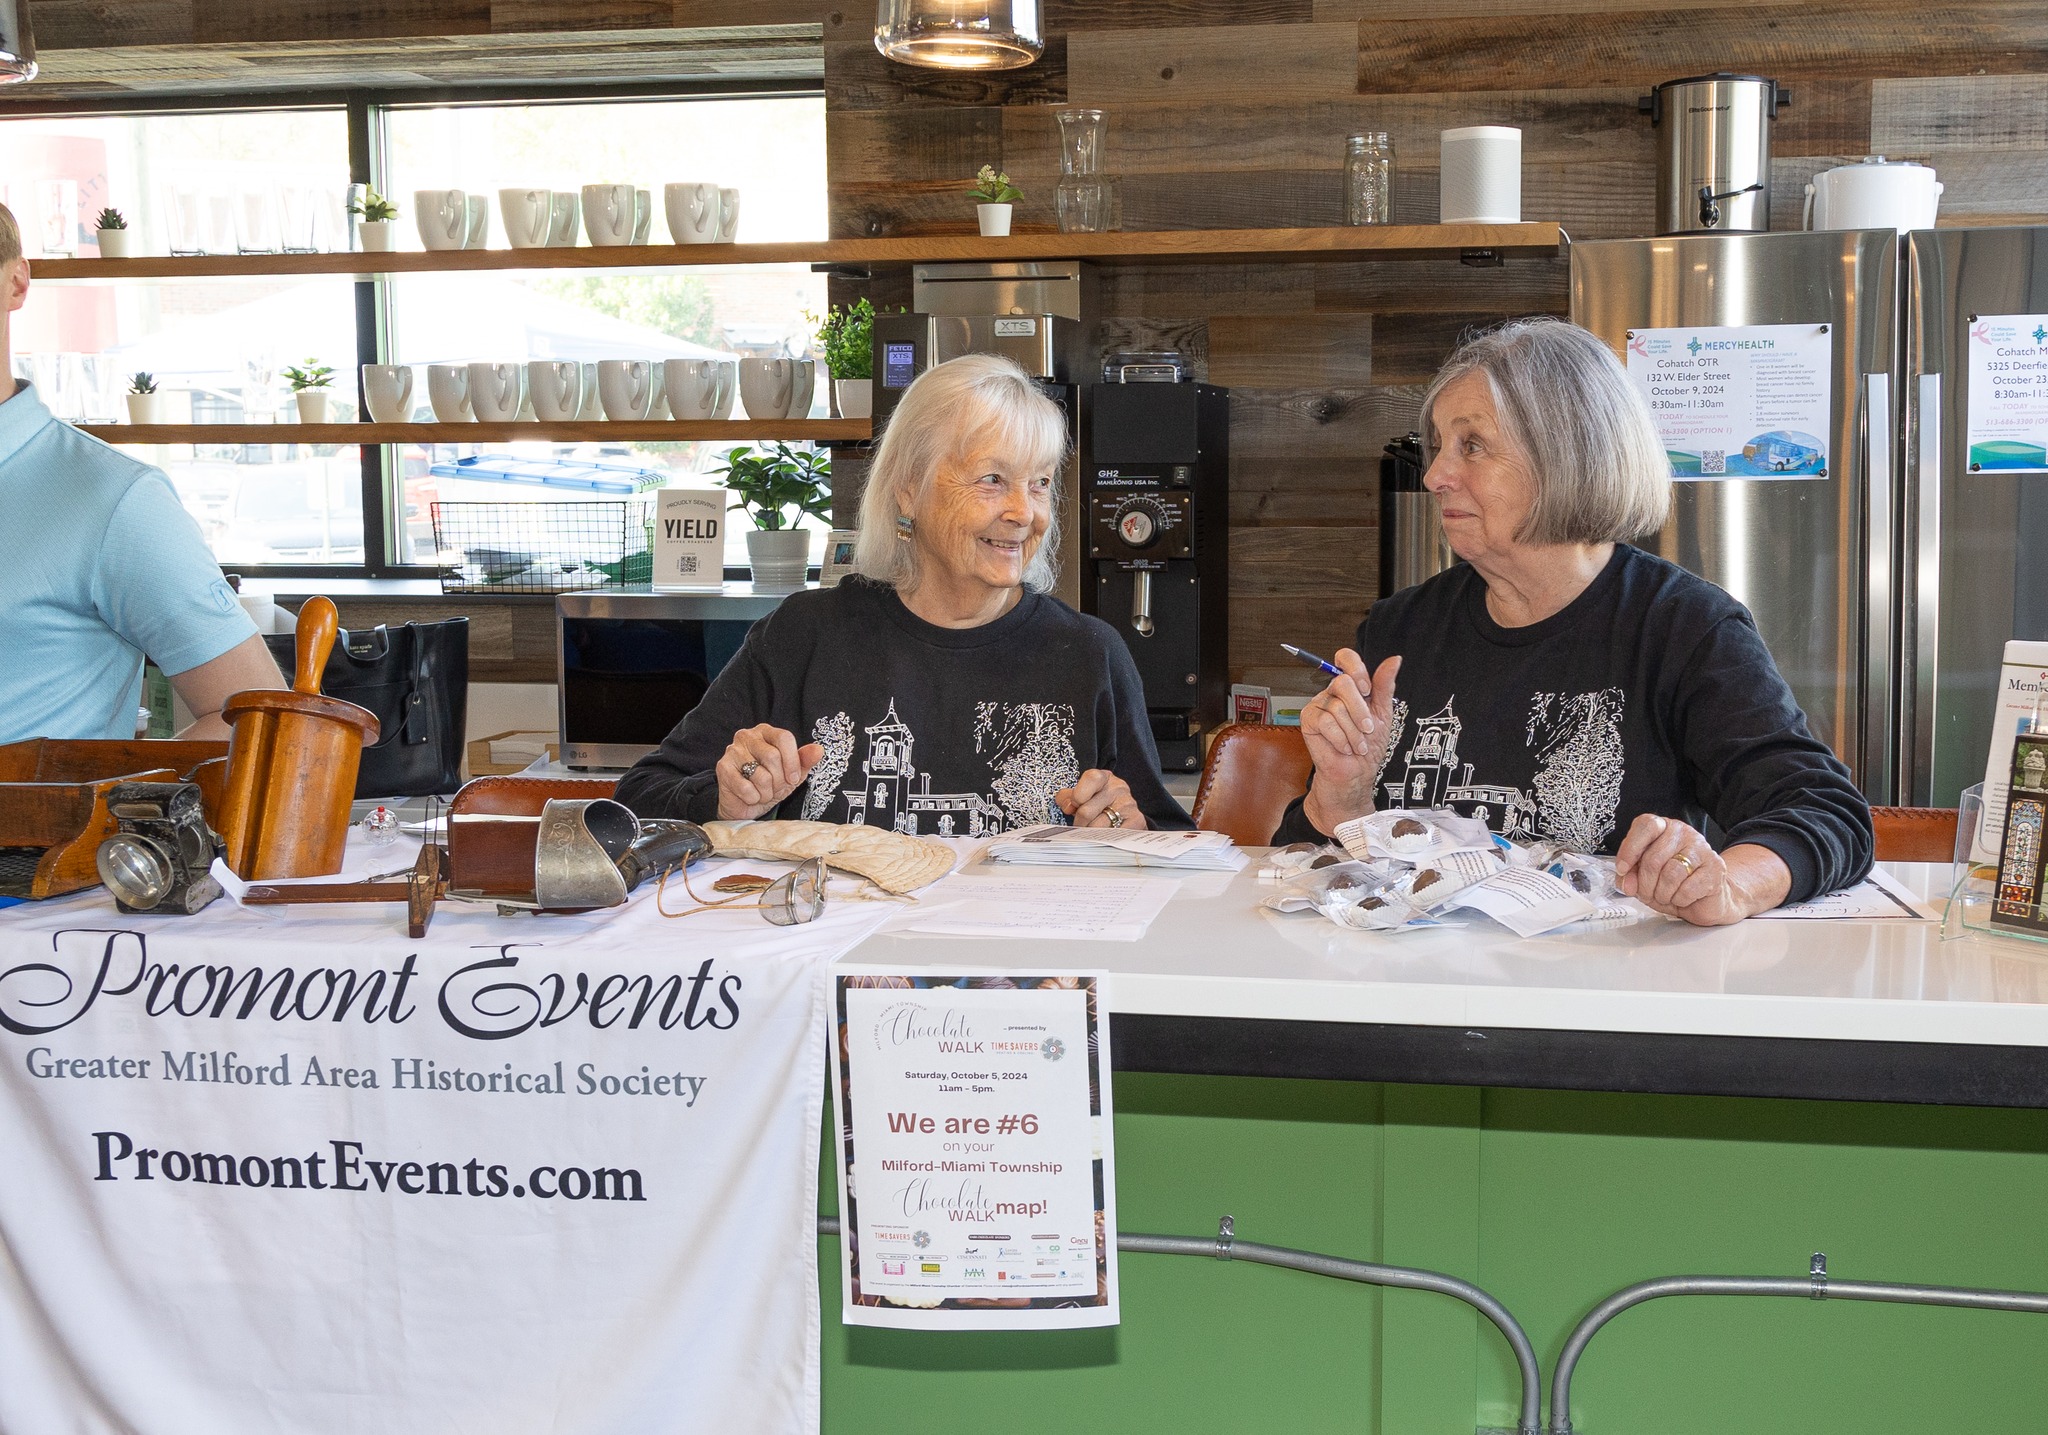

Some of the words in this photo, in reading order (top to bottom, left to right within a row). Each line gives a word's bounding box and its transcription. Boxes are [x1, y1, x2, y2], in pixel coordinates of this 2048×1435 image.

[1001, 322, 1029, 331] XTS
[1705, 339, 1775, 351] MERCYHEALTH
[1997, 347, 2036, 357] Cohatch
[1657, 359, 1694, 368] Cohatch
[1697, 358, 1719, 367] OTR
[1987, 362, 2010, 371] 5325
[1646, 373, 1662, 382] 132
[1663, 373, 1675, 382] W.
[1677, 373, 1701, 381] Elder
[1703, 371, 1731, 380] Street
[1992, 375, 2033, 385] October
[1651, 386, 1689, 396] October
[1692, 385, 1700, 395] 9,
[1702, 385, 1724, 394] 2024
[1651, 399, 1724, 409] 8:30am-11:30am
[1098, 470, 1119, 478] GH2
[666, 499, 692, 509] PROUDLY
[693, 499, 717, 510] SERVING
[664, 519, 718, 539] YIELD
[0, 929, 418, 1036] Promont
[438, 942, 742, 1041] Events
[882, 1008, 974, 1046] Chocolate
[938, 1041, 985, 1053] WALK
[991, 1042, 1009, 1051] TIME
[25, 1047, 150, 1081] Greater
[161, 1051, 290, 1087] Milford
[302, 1059, 379, 1090] Area
[391, 1057, 565, 1095] Historical
[576, 1063, 707, 1107] Society
[905, 1071, 949, 1081] Saturday,
[951, 1071, 989, 1080] October
[991, 1072, 1000, 1081] 5,
[1002, 1072, 1028, 1080] 2024
[972, 1085, 995, 1094] 5pm.
[888, 1113, 935, 1134] We
[944, 1117, 990, 1134] are
[996, 1113, 1039, 1135] #6
[943, 1142, 960, 1151] on
[964, 1142, 995, 1154] your
[92, 1131, 647, 1202] PromontEvents.com
[882, 1160, 986, 1172] Milford-Miami
[989, 1161, 1063, 1175] Township
[892, 1178, 993, 1219] Chocolate
[948, 1209, 995, 1222] WALK
[996, 1199, 1048, 1218] map!
[875, 1232, 888, 1240] TIME
